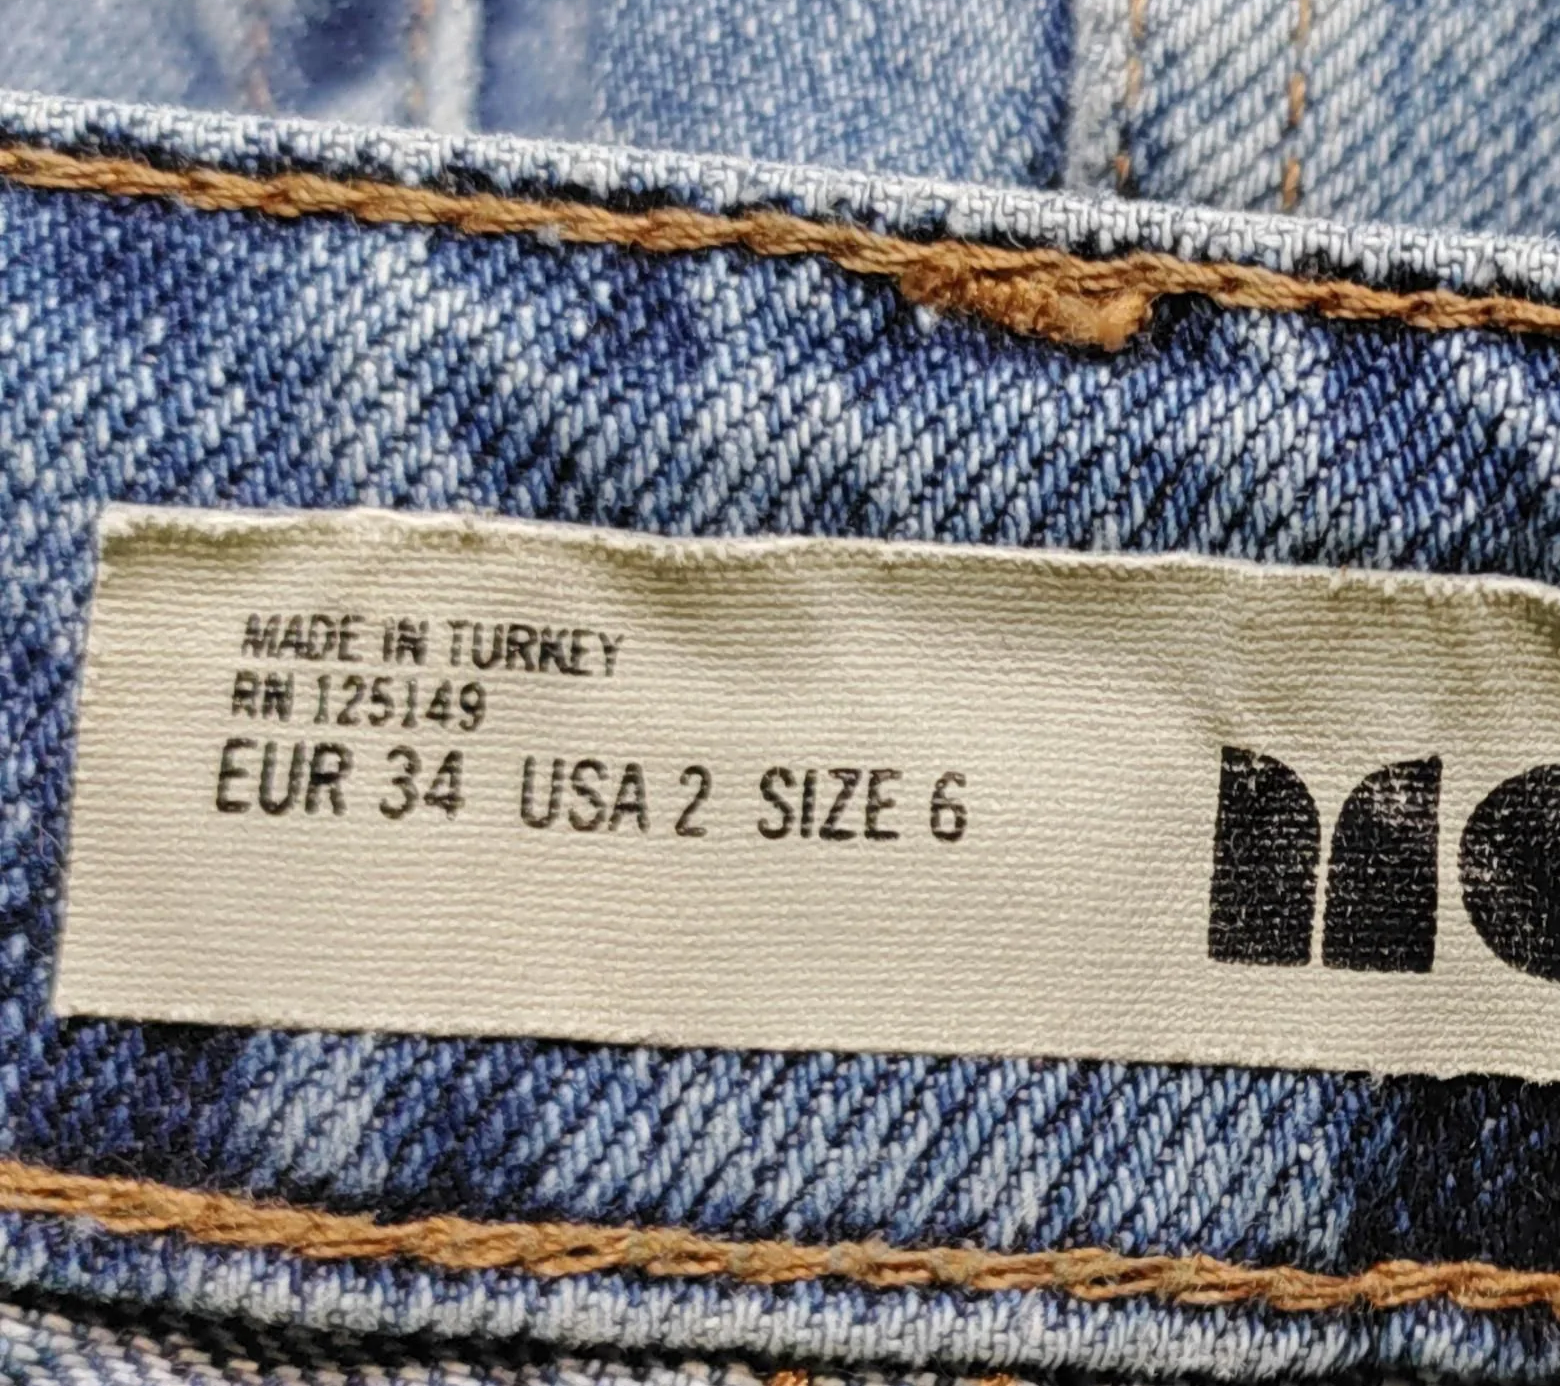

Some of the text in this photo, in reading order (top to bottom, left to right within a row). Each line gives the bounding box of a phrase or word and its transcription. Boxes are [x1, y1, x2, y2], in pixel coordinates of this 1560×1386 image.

[241, 613, 624, 676] MADE IN TURKEY
[231, 670, 487, 731] RN 125149
[216, 738, 968, 843] EUR 34 USA 2 SIZE 6
